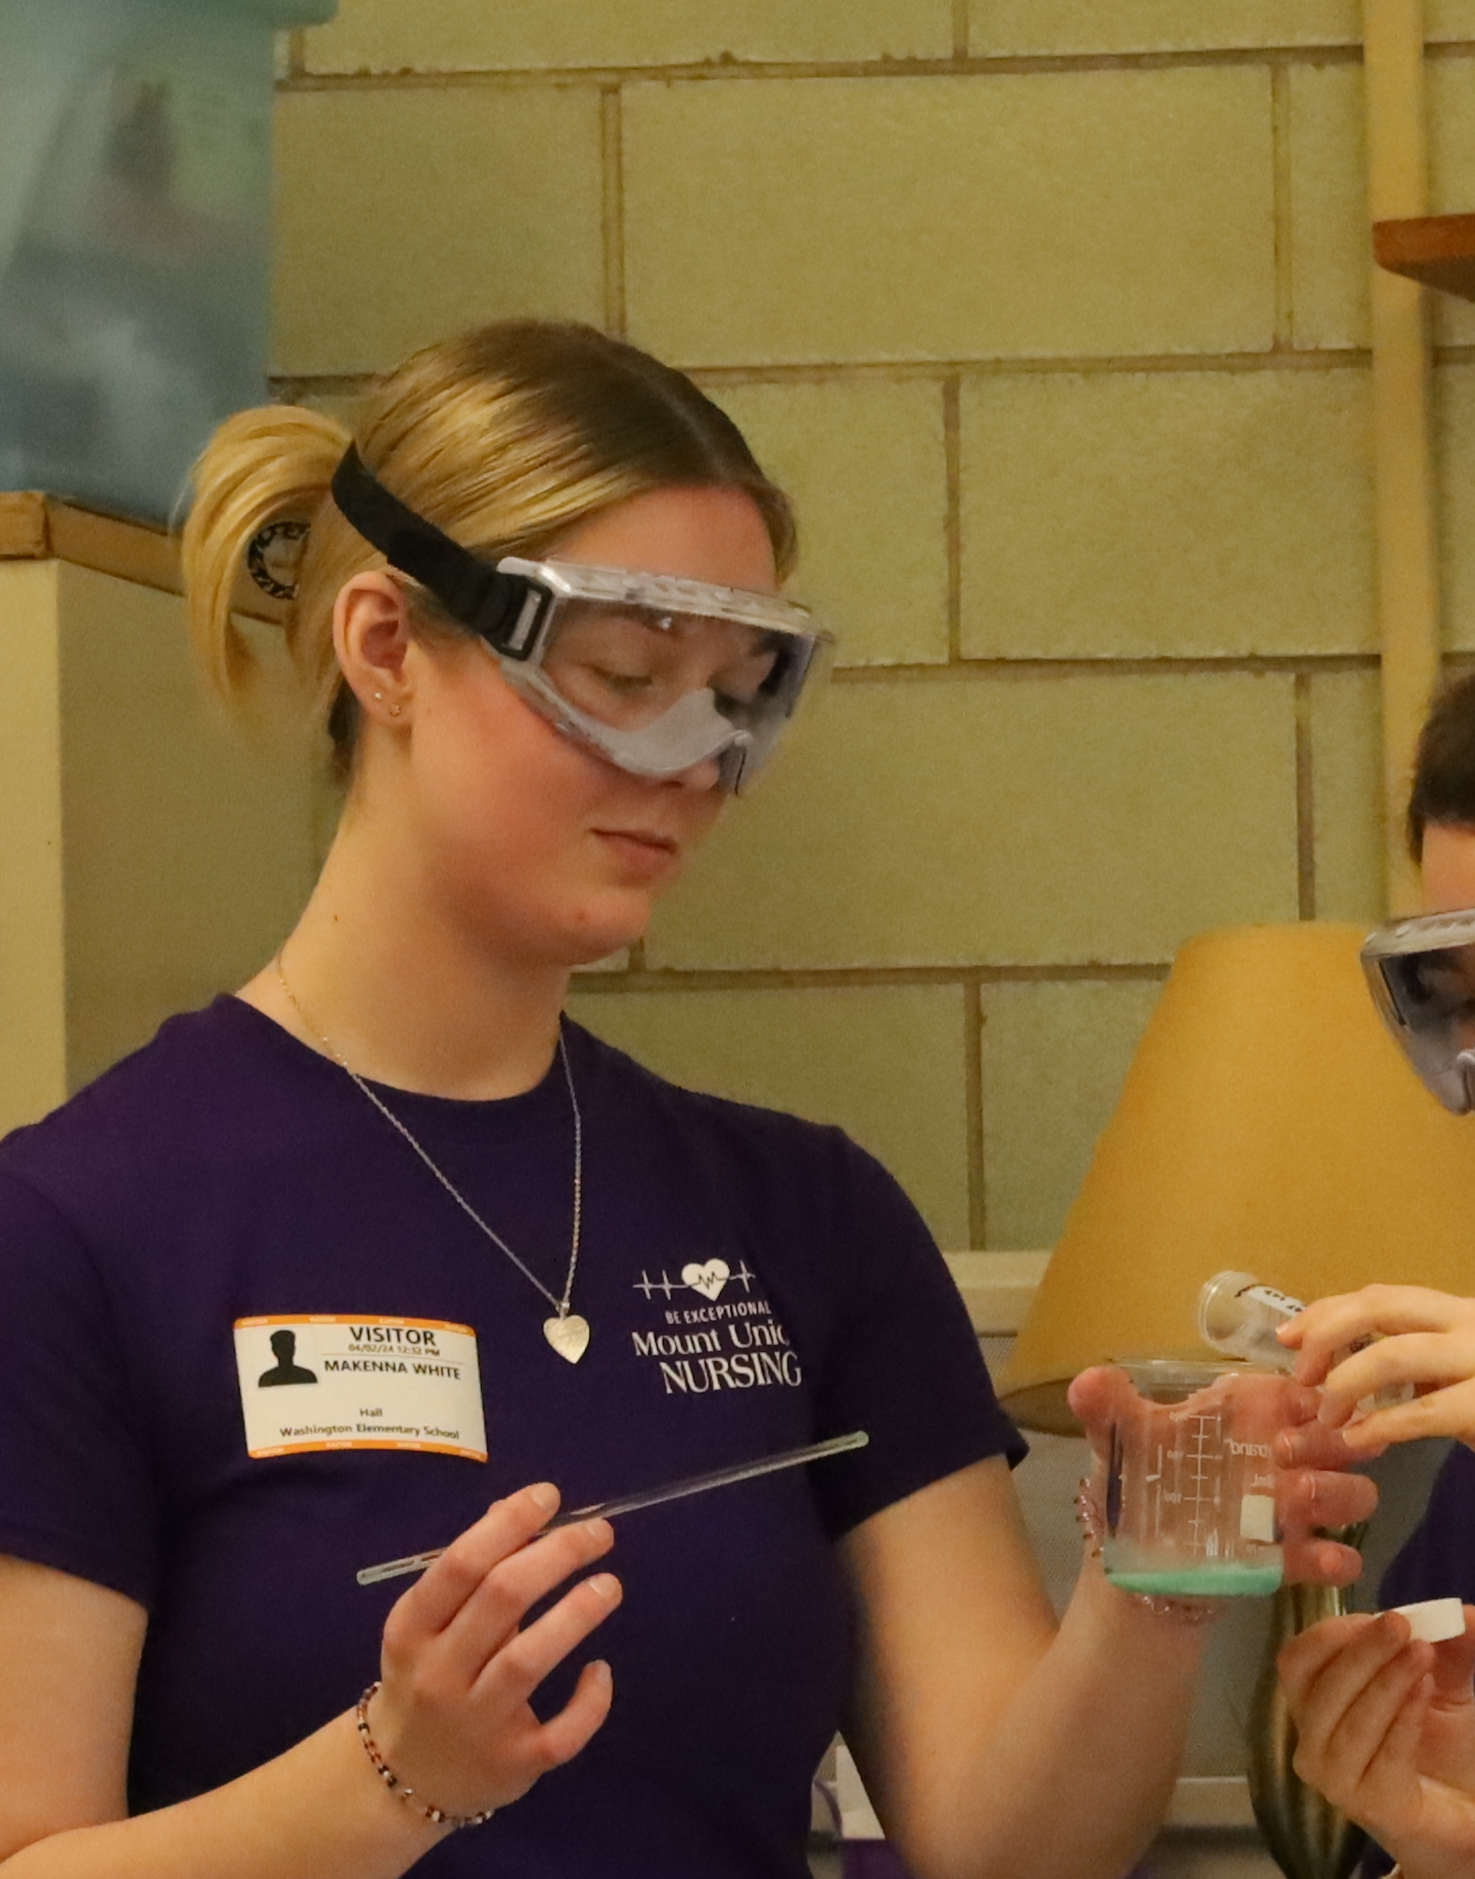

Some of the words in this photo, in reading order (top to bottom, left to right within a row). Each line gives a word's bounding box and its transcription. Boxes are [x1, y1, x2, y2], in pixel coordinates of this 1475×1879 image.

[665, 1310, 681, 1325] BE
[684, 1300, 772, 1325] EXCEPTIONAL
[349, 1325, 437, 1347] VISITOR
[631, 1328, 722, 1357] Mount
[324, 1359, 408, 1374] MAKENNA
[412, 1362, 461, 1380] WHITE
[659, 1351, 802, 1395] NURSING
[359, 1407, 383, 1418] Hall
[279, 1424, 353, 1438] Washington
[356, 1424, 420, 1438] Elementary
[423, 1425, 460, 1441] School
